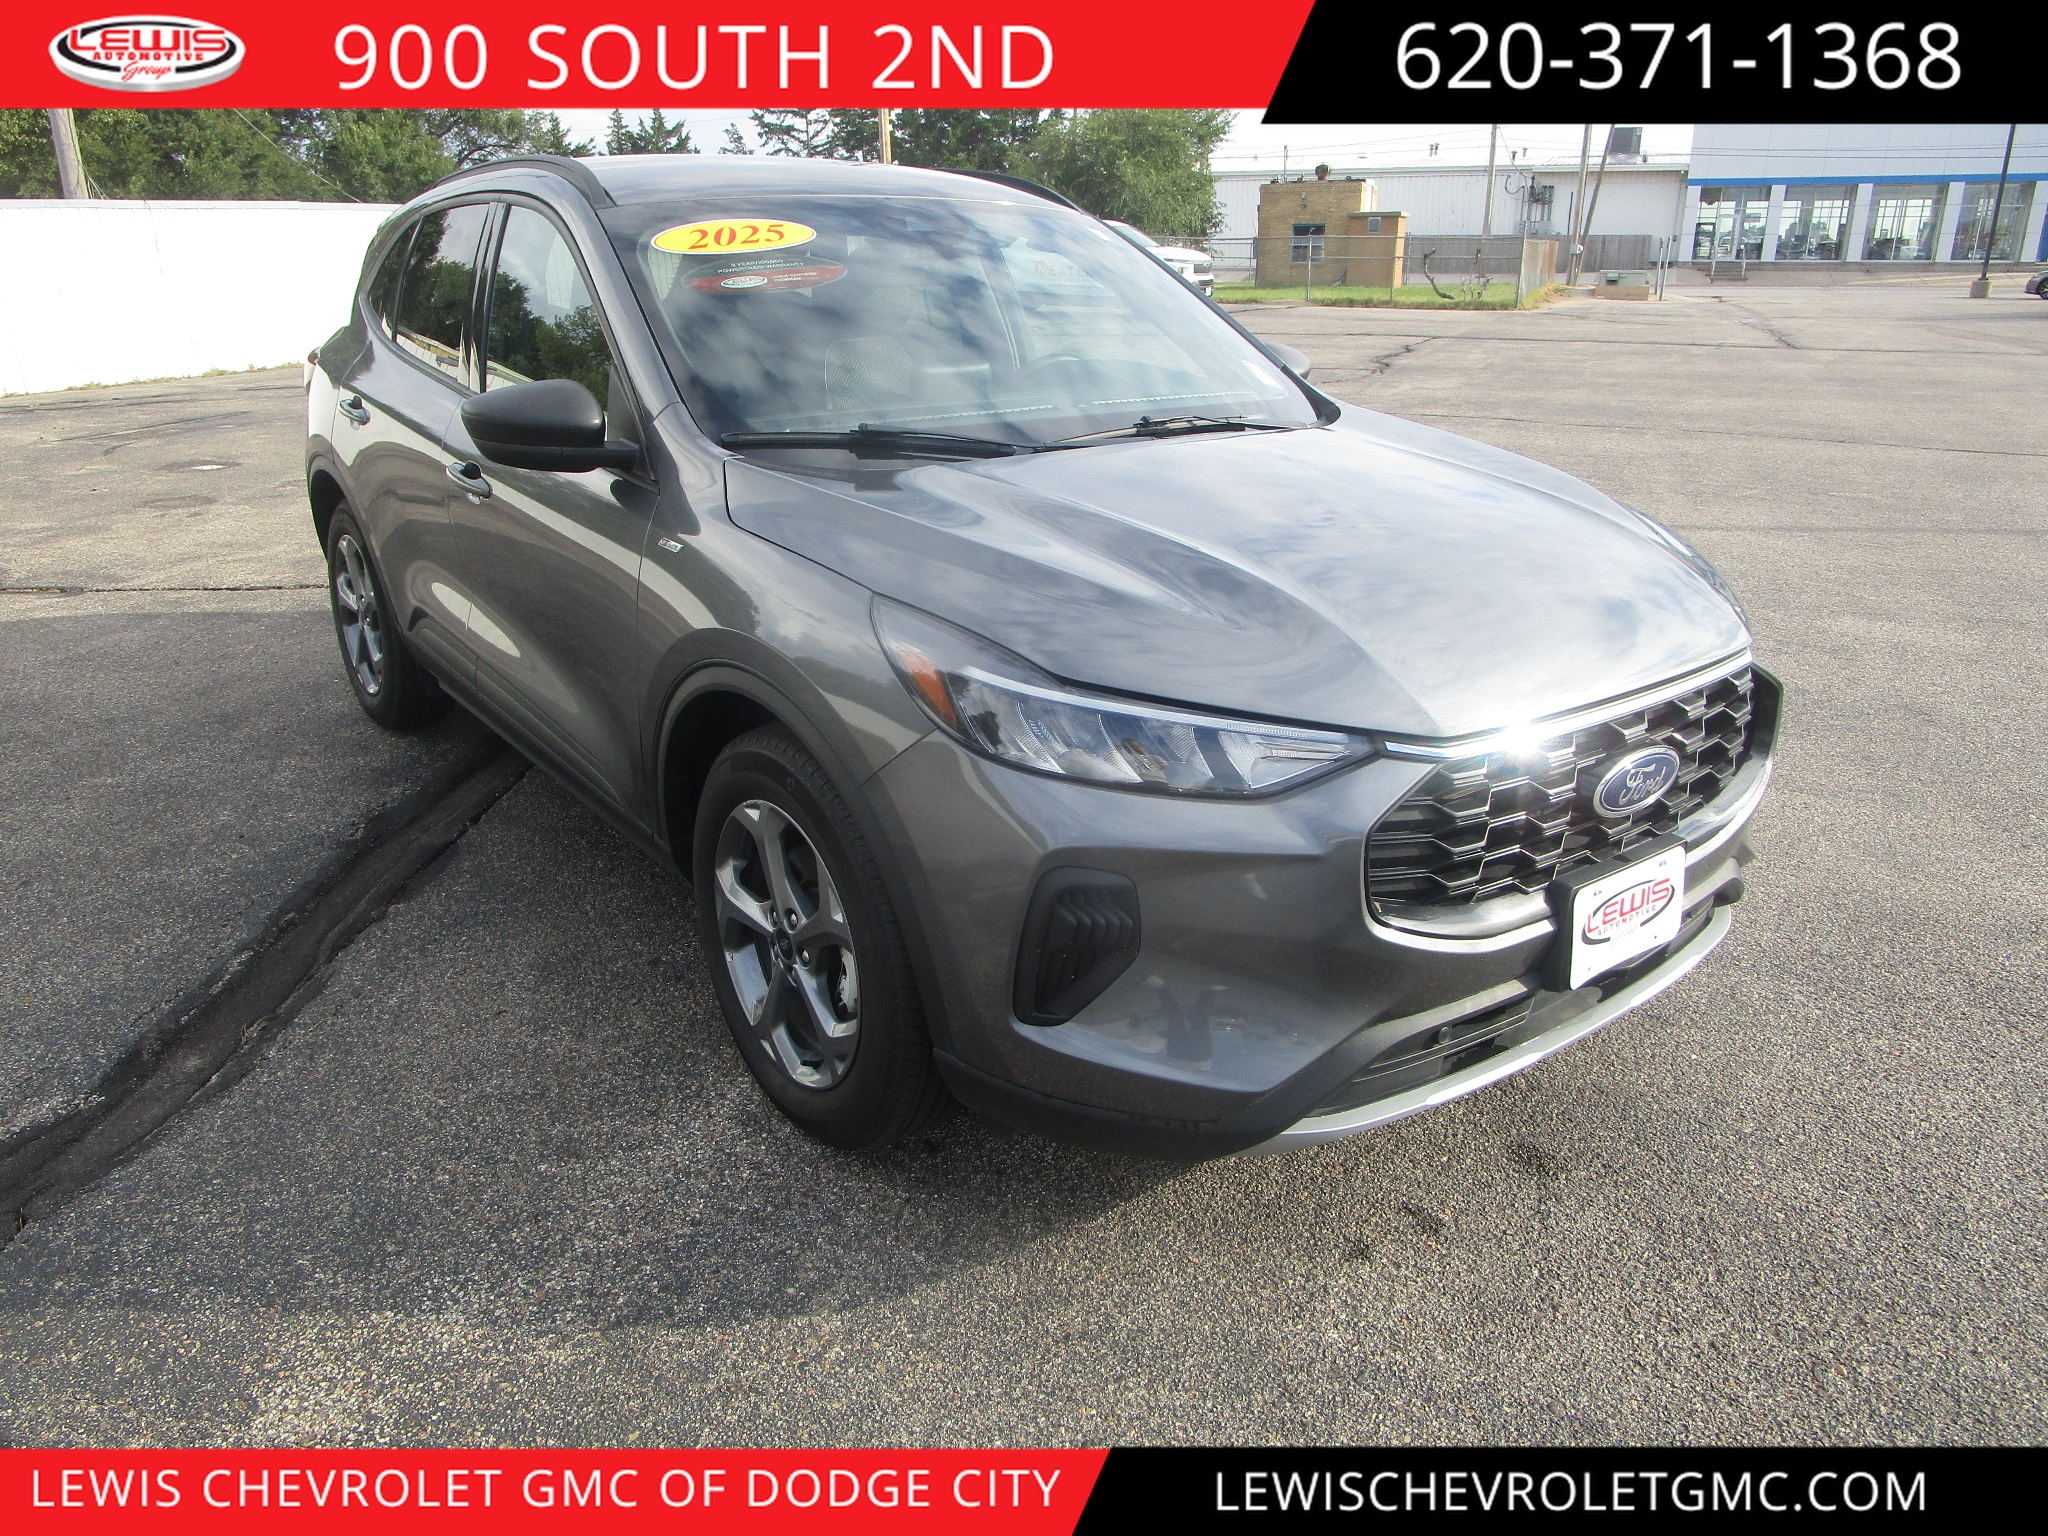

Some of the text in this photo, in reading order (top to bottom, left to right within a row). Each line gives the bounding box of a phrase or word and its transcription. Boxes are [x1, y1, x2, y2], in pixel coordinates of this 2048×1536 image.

[687, 224, 785, 250] 2025
[1618, 764, 1666, 806] Ford
[1587, 877, 1671, 934] LEWIS
[1597, 904, 1657, 937] AUTOMOTIVE
